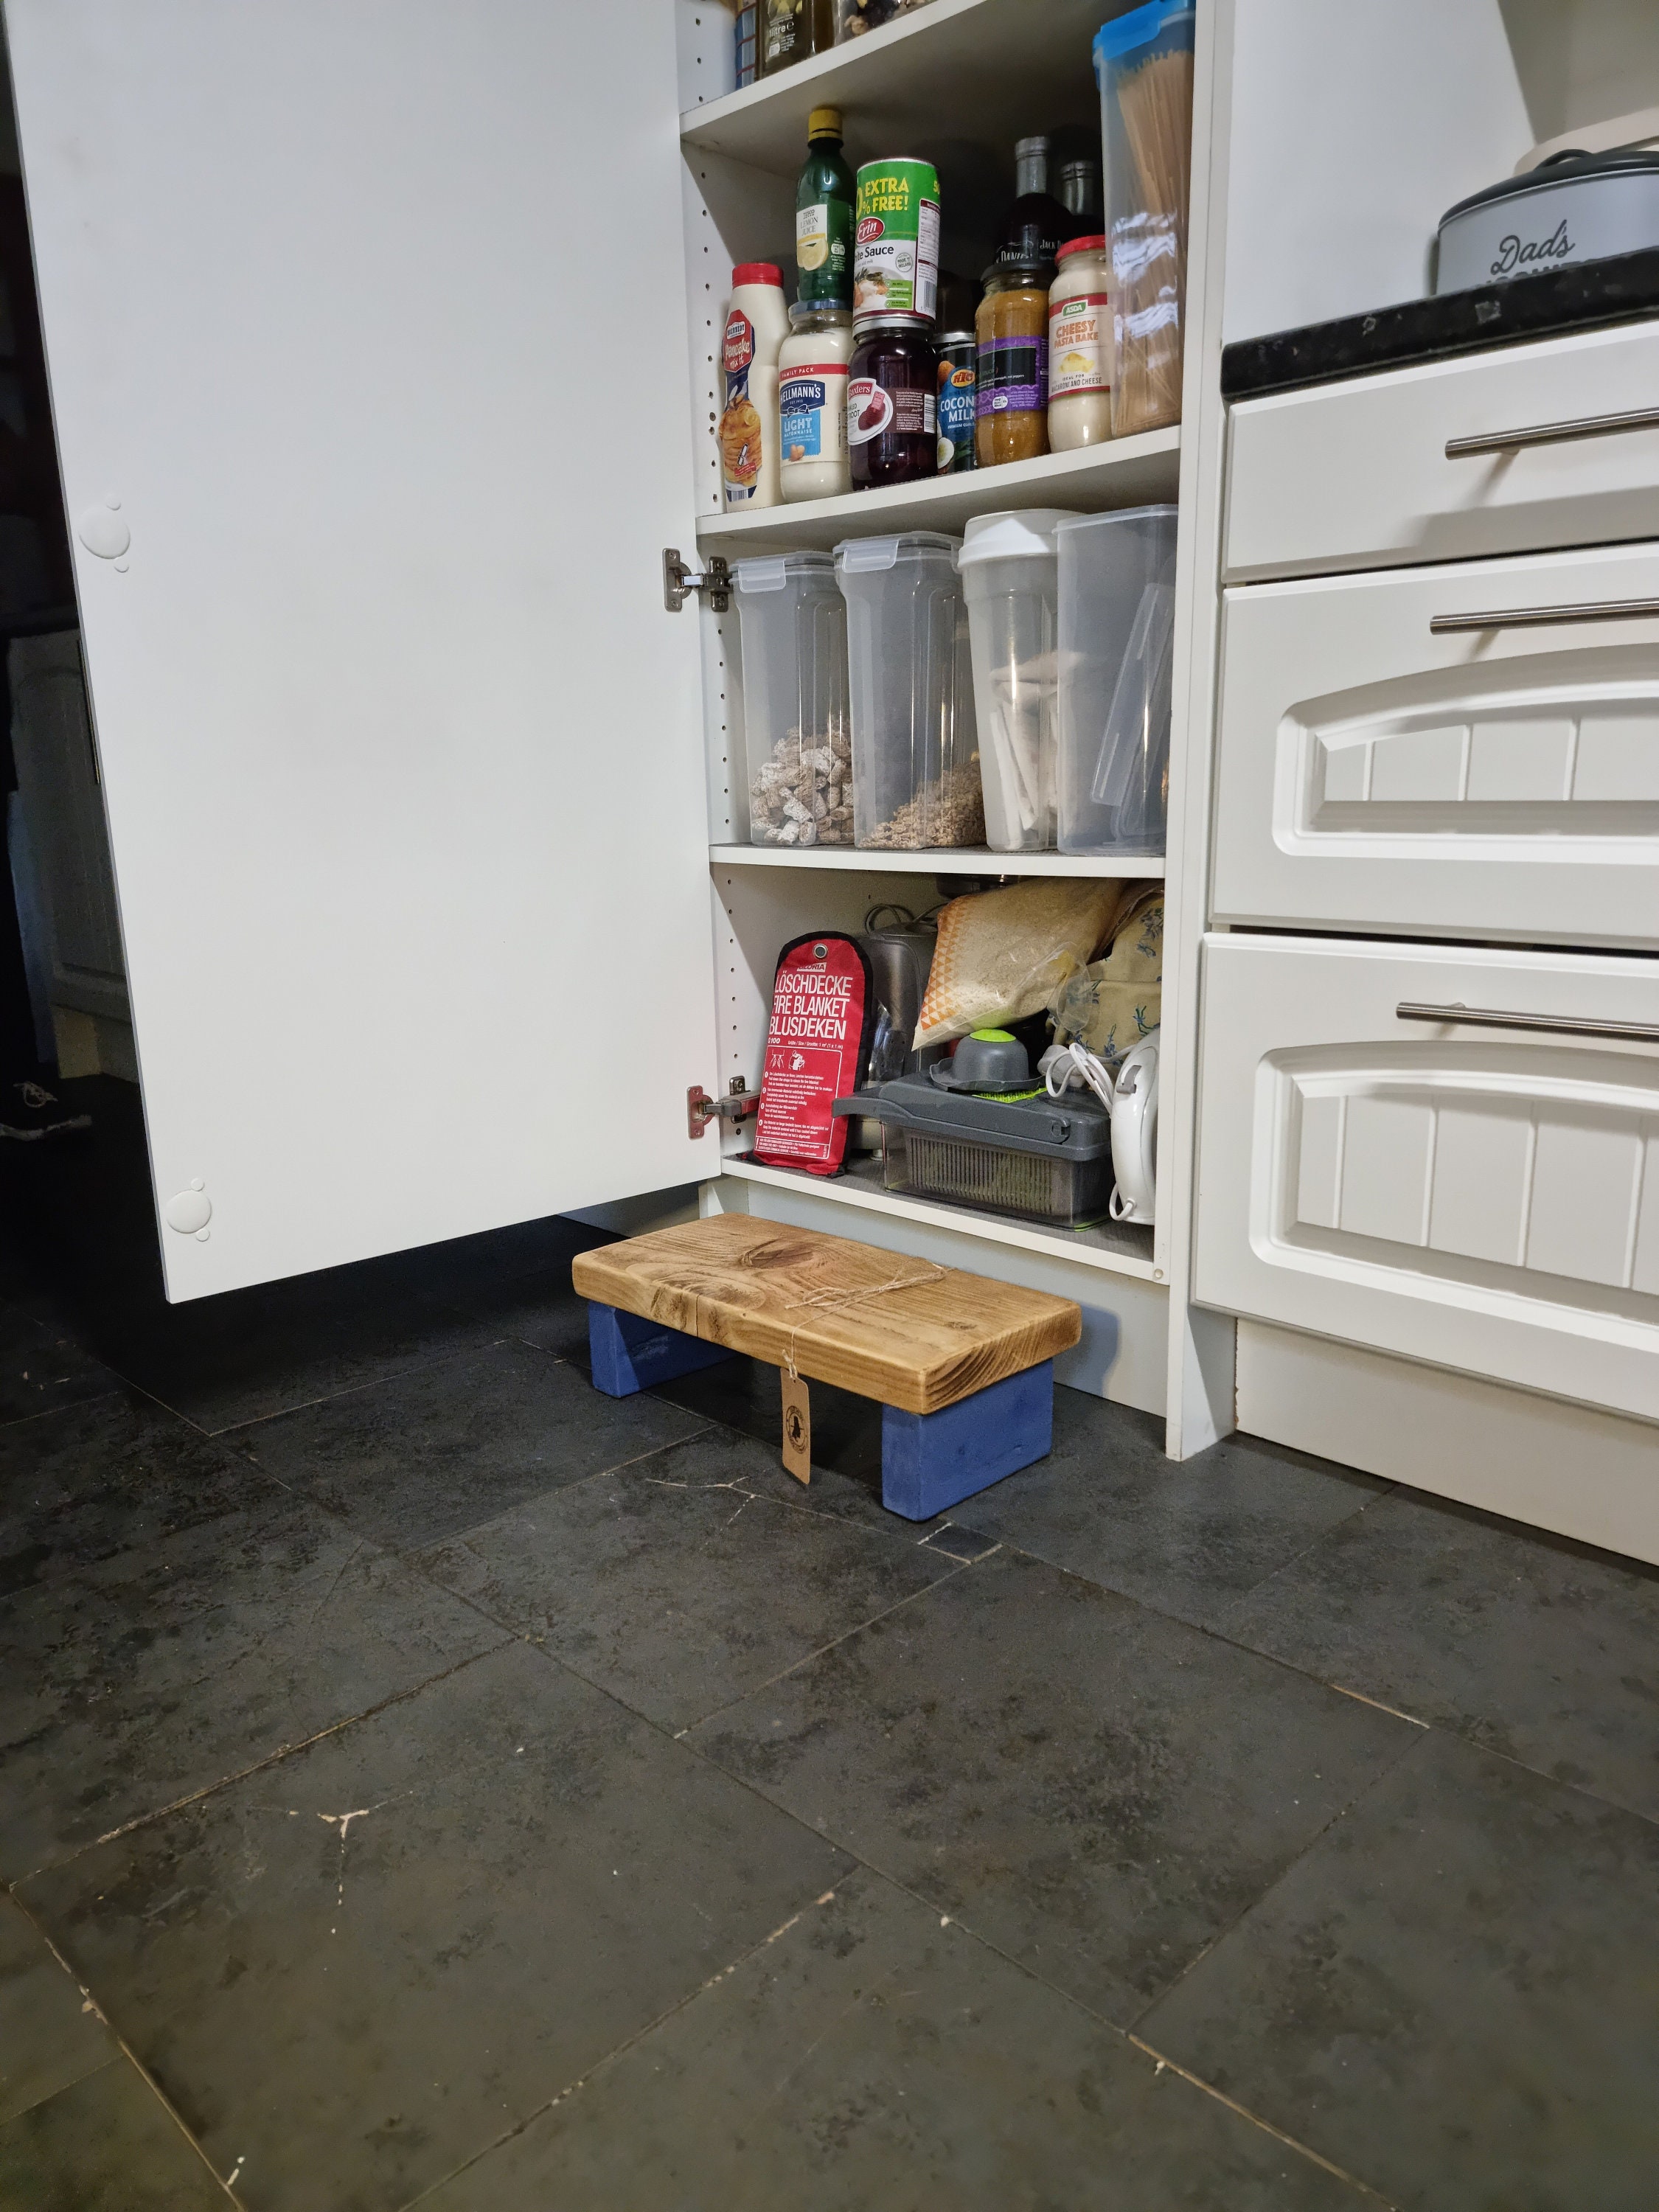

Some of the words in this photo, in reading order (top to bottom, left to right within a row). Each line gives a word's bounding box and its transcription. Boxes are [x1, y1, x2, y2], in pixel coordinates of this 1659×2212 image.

[865, 177, 909, 198] EXTRA
[872, 195, 909, 213] FREE!
[803, 209, 815, 218] TESCO
[801, 217, 818, 229] LEMON
[802, 225, 816, 236] JUICE
[857, 221, 877, 237] Erin
[865, 246, 894, 258] Sauce
[1490, 220, 1576, 275] Dad's
[1066, 305, 1083, 314] ASDA
[1056, 320, 1096, 338] CHEESY
[1054, 336, 1074, 349] PASTA
[1075, 332, 1099, 342] BAKE
[725, 338, 751, 361] Pancake
[1071, 379, 1081, 387] AND
[1082, 377, 1102, 386] CHEESE
[940, 396, 975, 413] COCON
[784, 417, 813, 433] LIGHT
[774, 970, 854, 996] LÖSCHDECKE
[772, 995, 793, 1015] FIRE
[793, 996, 850, 1018] BLANKET
[769, 1016, 847, 1040] BLUSDEKEN
